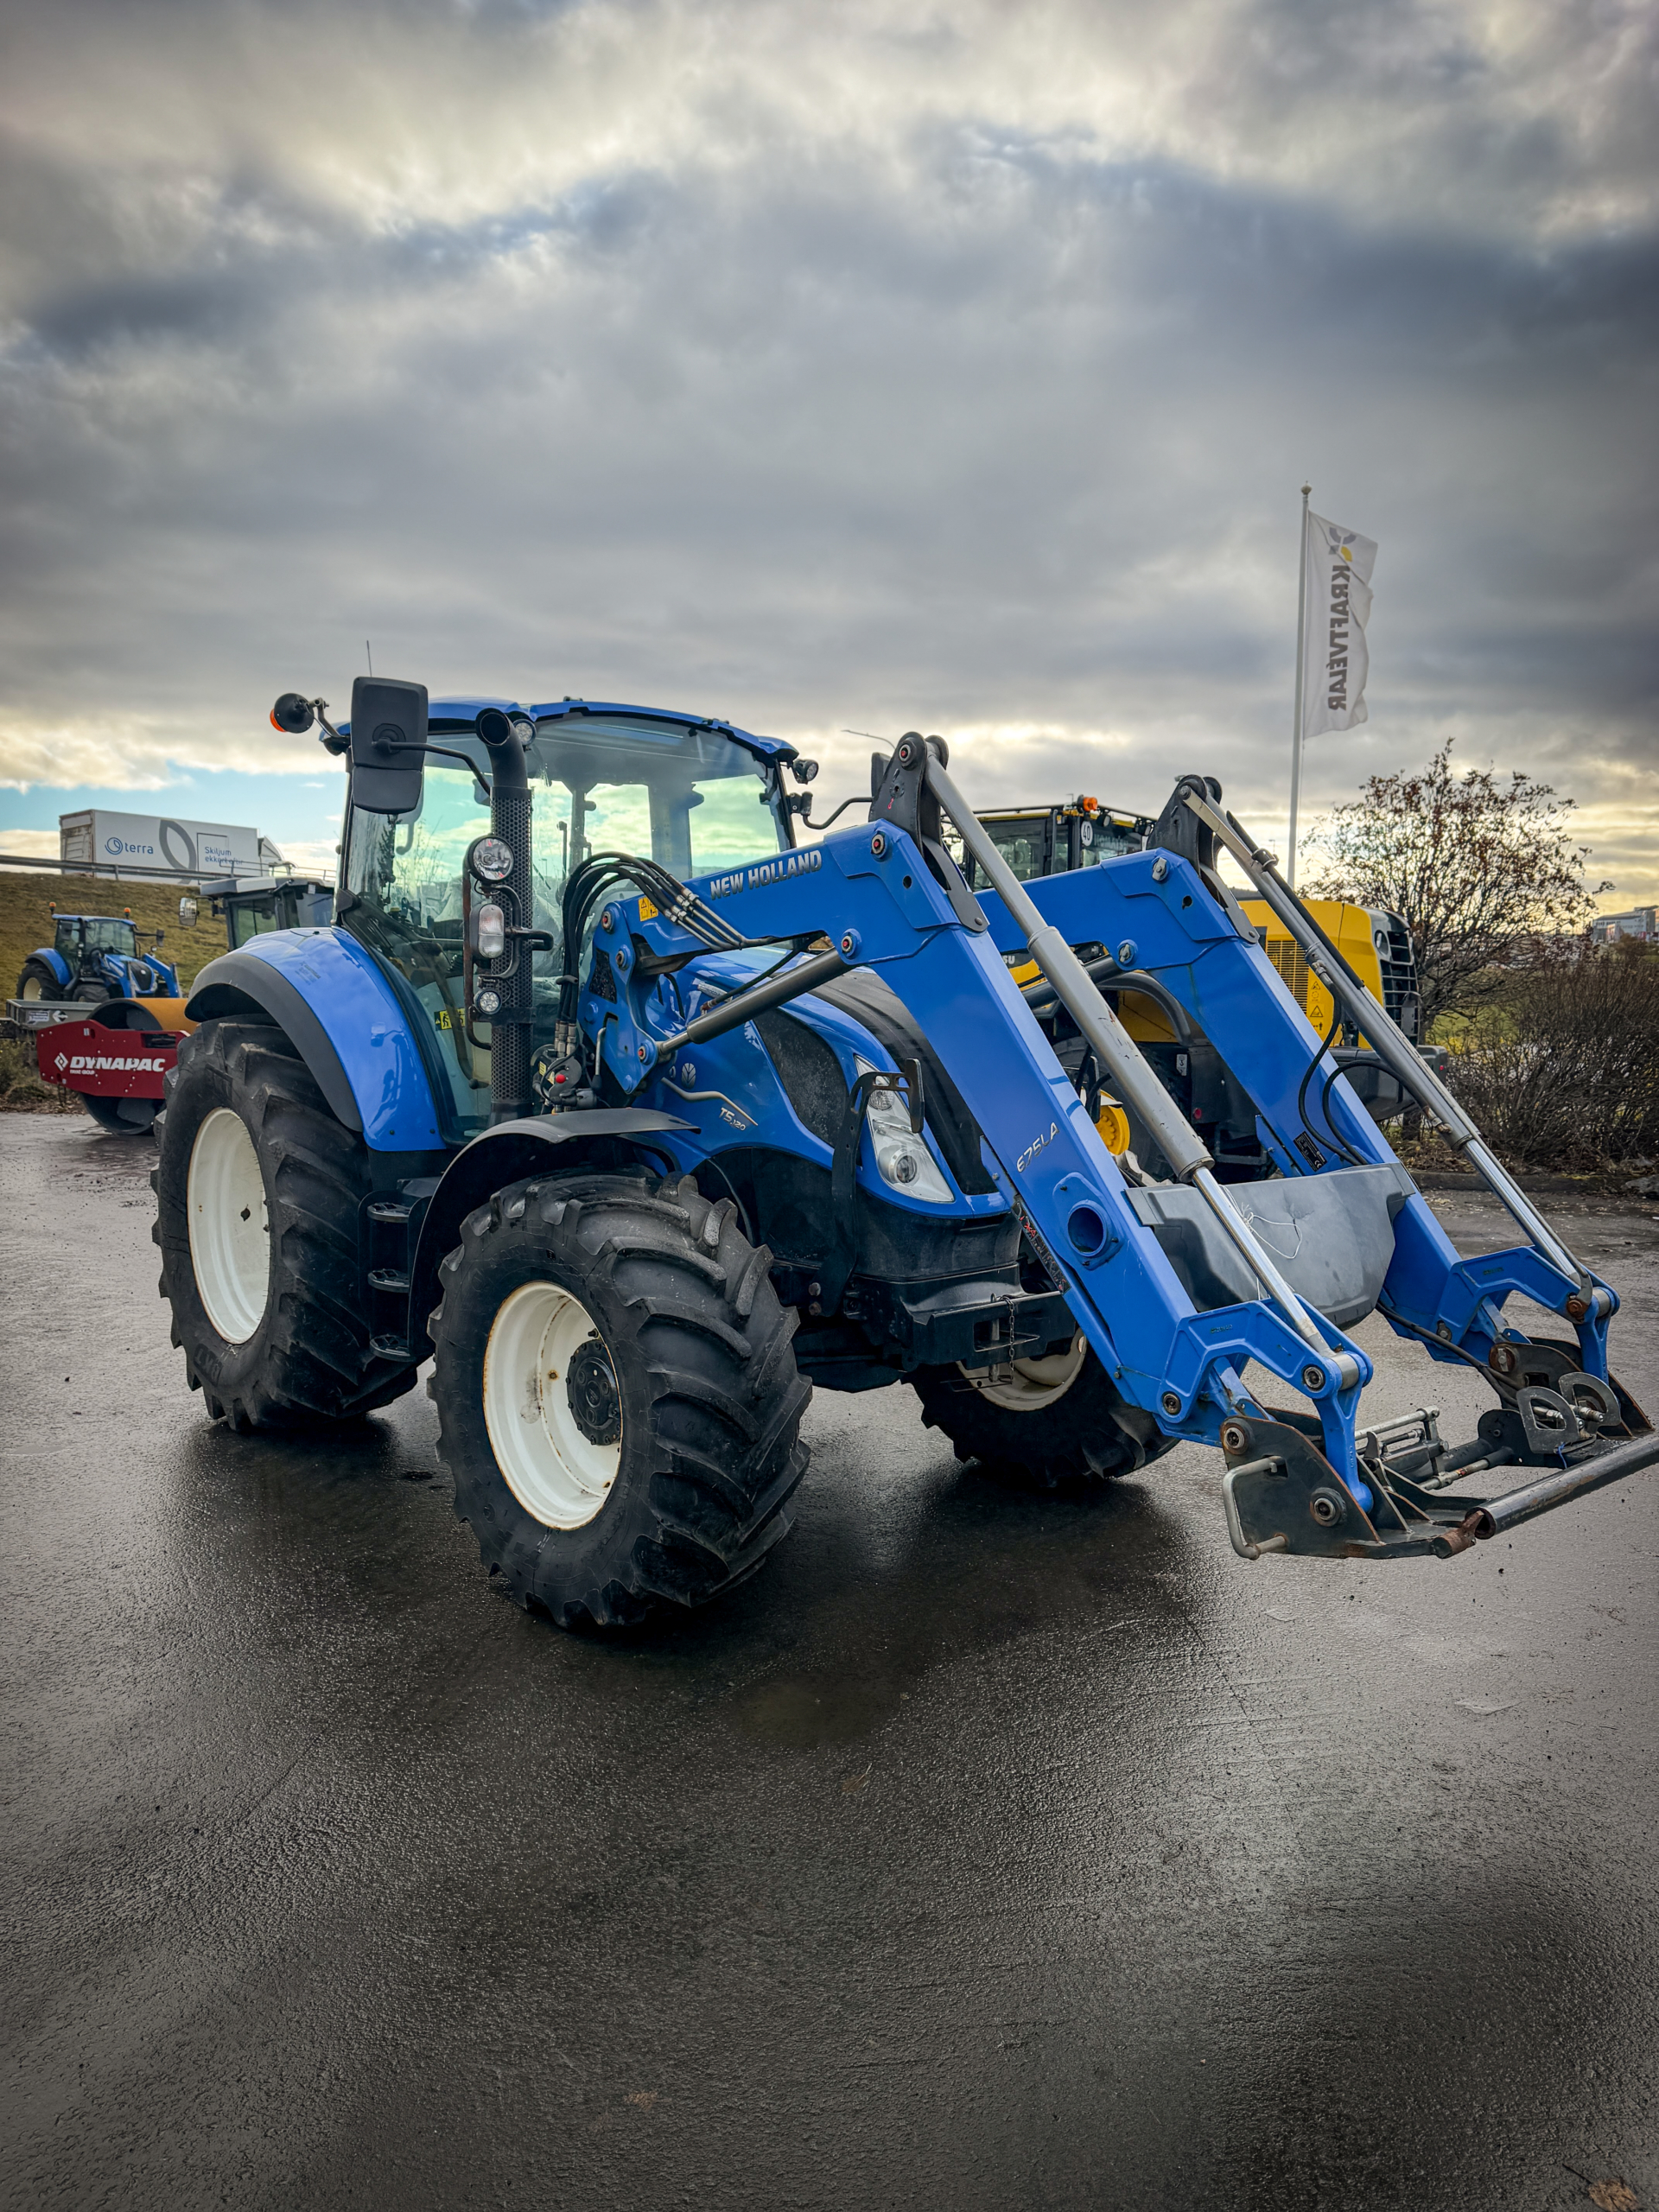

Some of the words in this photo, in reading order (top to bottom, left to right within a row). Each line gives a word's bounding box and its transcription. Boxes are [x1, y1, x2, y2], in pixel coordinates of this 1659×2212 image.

[1083, 824, 1090, 841] 40
[124, 842, 154, 855] terra
[205, 846, 232, 856] Skiljum
[710, 872, 744, 901] NEW
[747, 849, 823, 890] HOLLAND
[70, 1056, 166, 1072] DYNAPAC
[1016, 1122, 1060, 1173] 675LA
